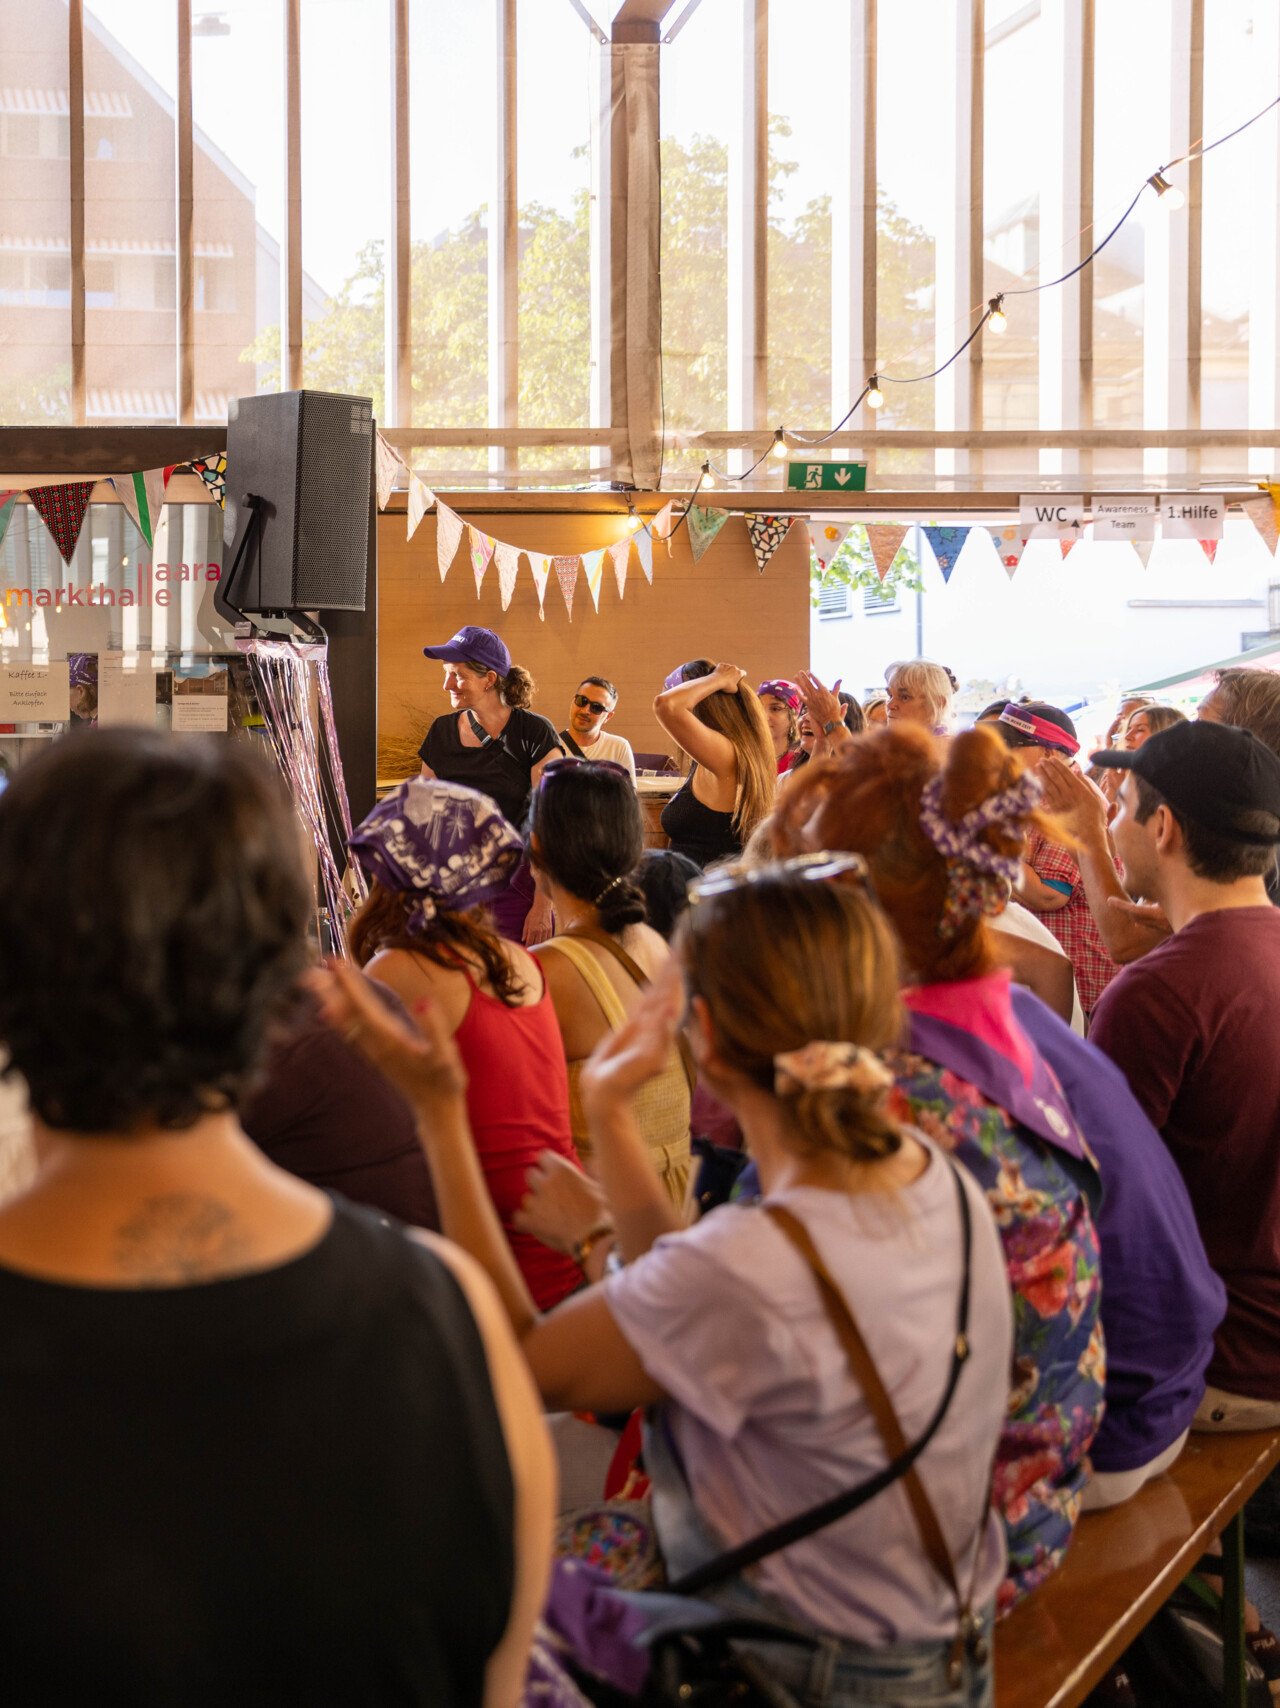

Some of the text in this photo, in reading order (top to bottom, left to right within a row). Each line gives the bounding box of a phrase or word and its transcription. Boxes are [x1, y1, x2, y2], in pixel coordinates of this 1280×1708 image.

[1035, 507, 1068, 522] WC
[1097, 504, 1149, 514] Awareness
[1168, 505, 1219, 519] 1.Hilfe
[1111, 520, 1136, 529] Team
[155, 562, 221, 582] aara
[5, 564, 172, 608] markthalle
[8, 669, 35, 681] Kaffee
